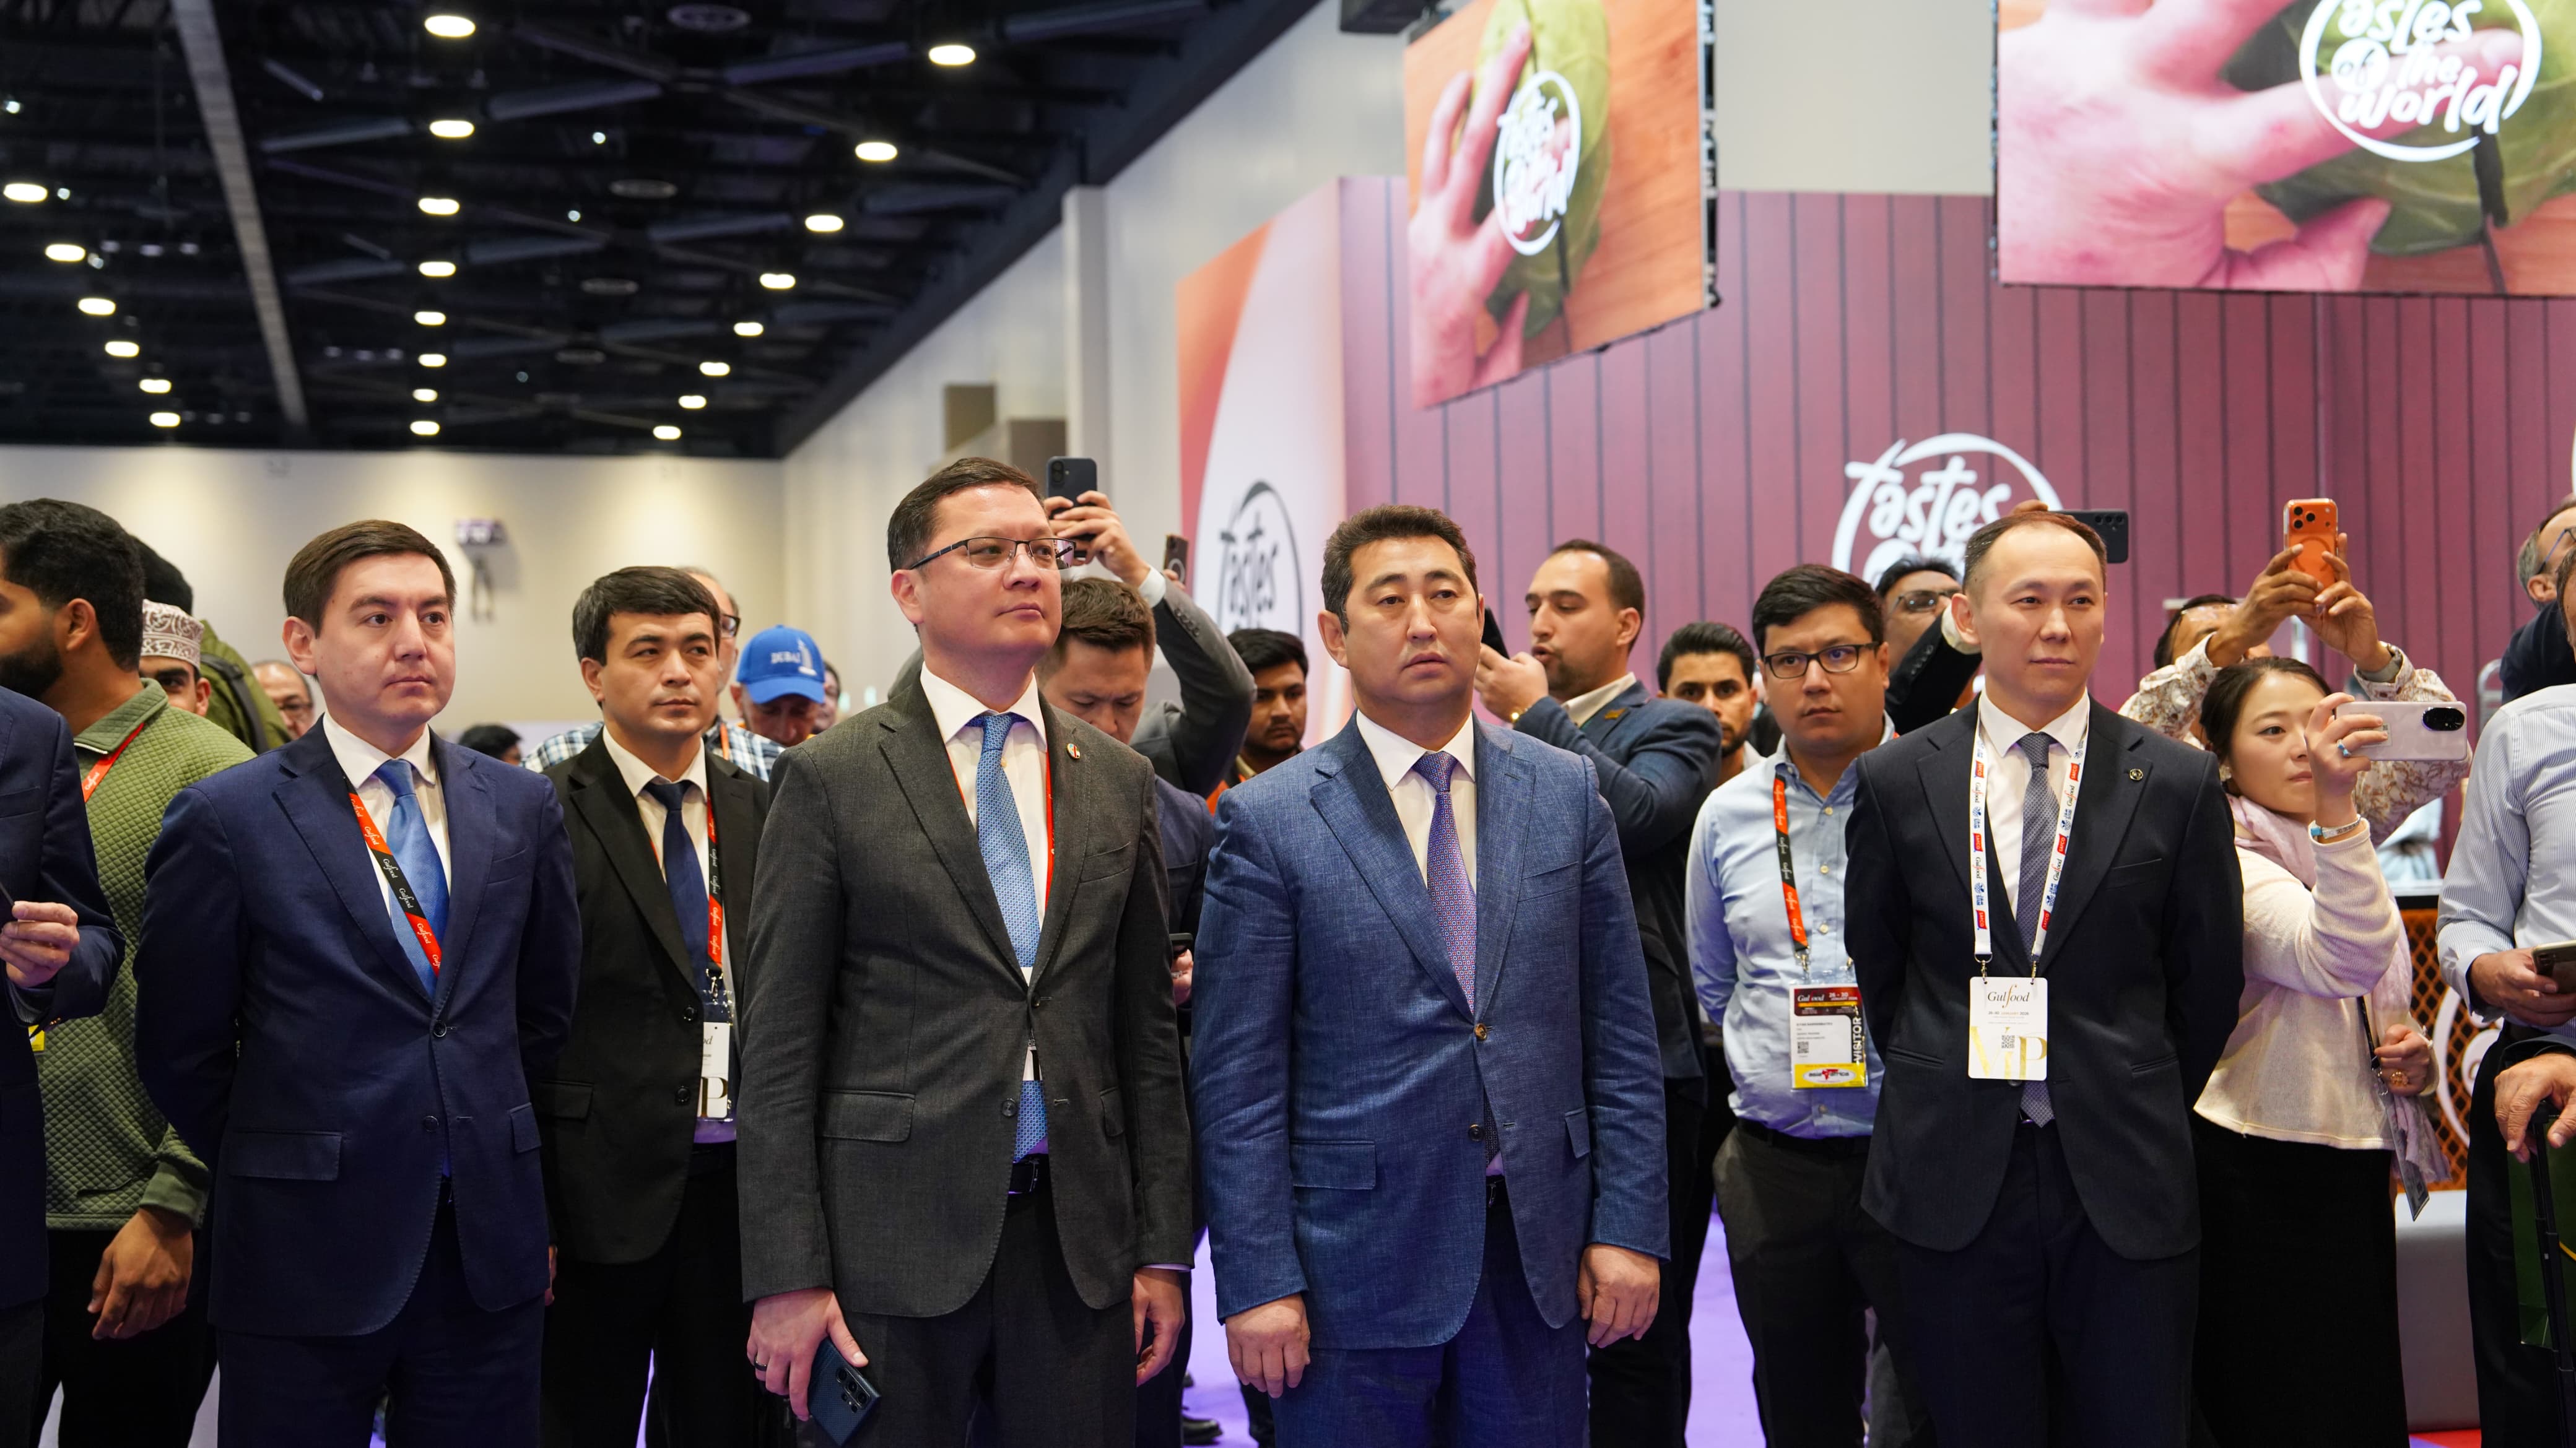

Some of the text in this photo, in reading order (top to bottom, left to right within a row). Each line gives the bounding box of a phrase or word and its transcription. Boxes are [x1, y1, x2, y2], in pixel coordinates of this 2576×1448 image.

[2395, 40, 2464, 90] the
[2338, 64, 2519, 134] world
[771, 651, 801, 664] DUBAI
[1972, 783, 1984, 803] Gulfood
[2065, 785, 2076, 806] Gulfood
[364, 826, 380, 846] Gulfood
[383, 858, 398, 878] Gulfood
[1973, 857, 1985, 878] Gulfood
[2052, 859, 2062, 880] Gulfood
[399, 888, 414, 909] Gulfood
[417, 923, 431, 944] Gulfood
[1988, 985, 2030, 1008] Gulfood
[1852, 1017, 1862, 1062] VISITOR
[1970, 1026, 2047, 1079] VIP
